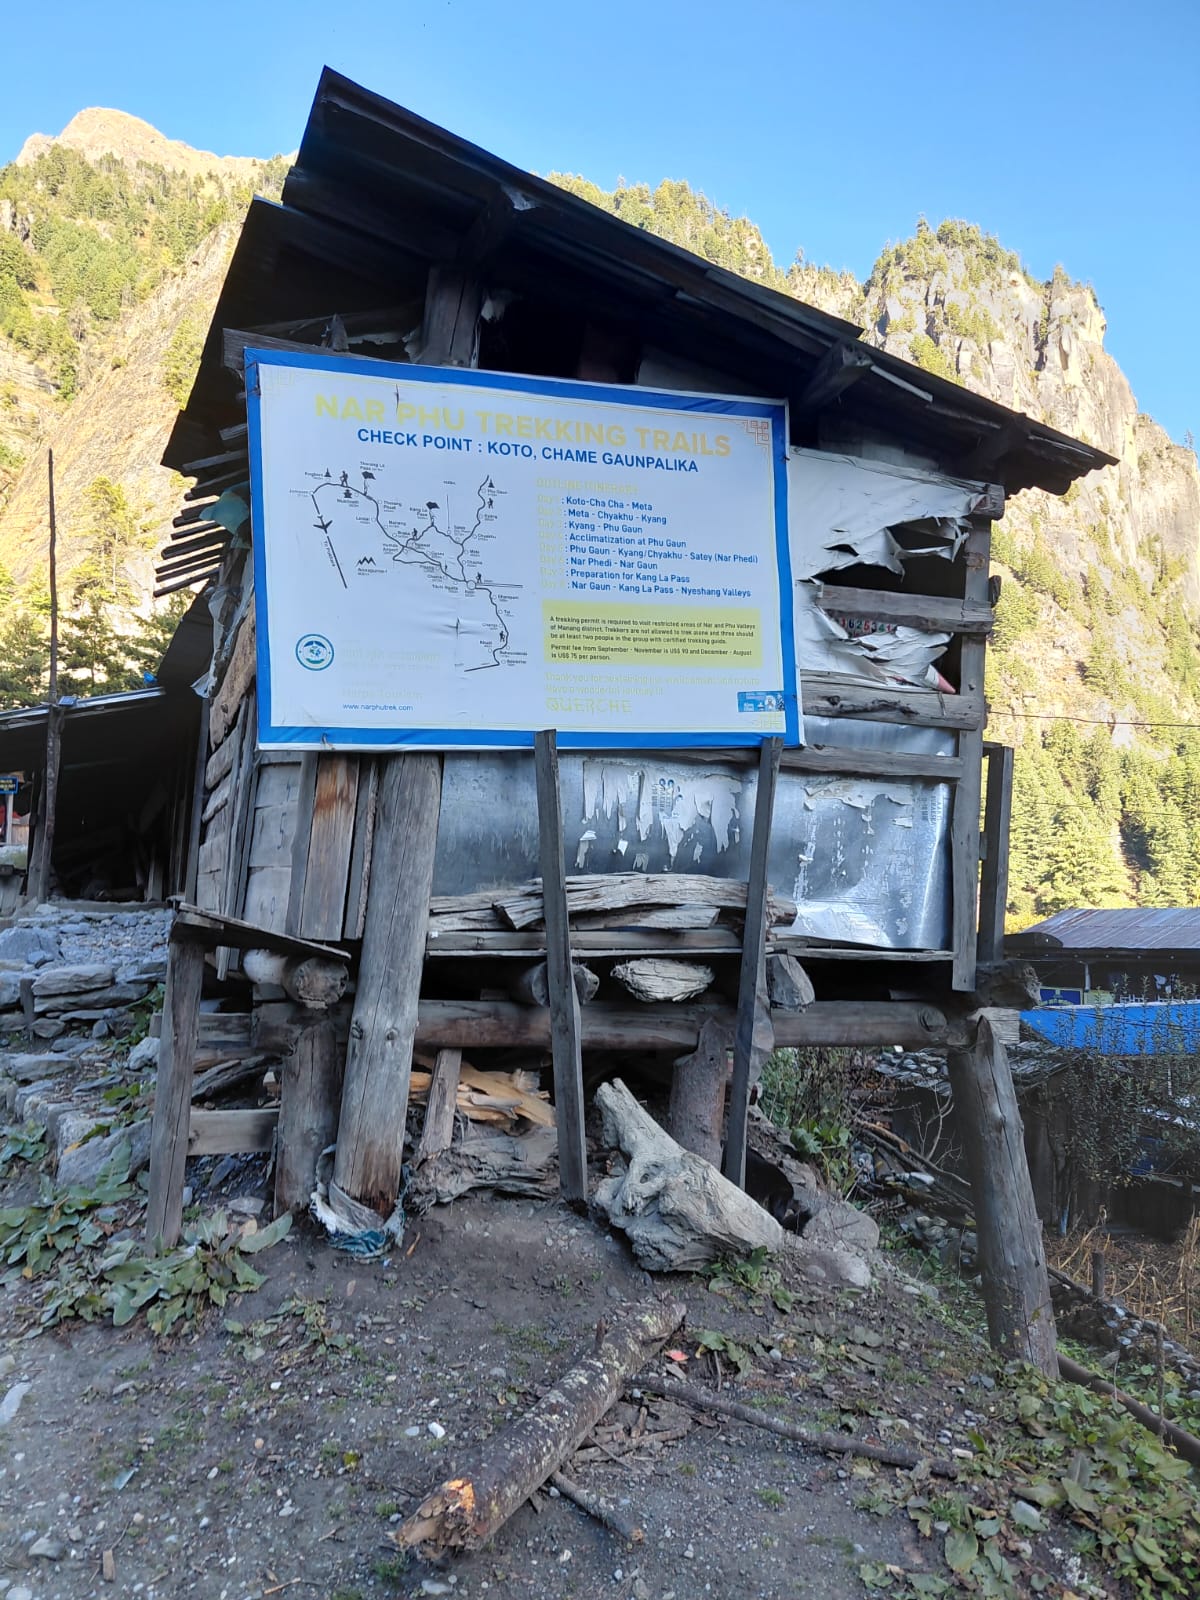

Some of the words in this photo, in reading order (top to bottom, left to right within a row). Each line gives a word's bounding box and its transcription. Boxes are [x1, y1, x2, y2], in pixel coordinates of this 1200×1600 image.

[315, 393, 385, 423] NAR
[399, 402, 465, 431] PHU
[475, 410, 626, 447] TREKKING
[634, 426, 731, 457] TRAILS
[357, 428, 418, 447] CHECK
[423, 435, 472, 451] POINT
[487, 441, 537, 460] KOTO,
[542, 447, 598, 464] CHAME
[602, 452, 698, 473] GAUNPALIKA
[566, 496, 606, 507] Koto-Cha
[608, 500, 624, 508] Cha
[632, 502, 652, 511] Meta
[568, 509, 589, 518] Meta
[598, 511, 634, 521] Chyakhu
[642, 514, 666, 525] Kyang
[569, 521, 595, 532] Kyang
[604, 523, 620, 532] Phu
[622, 524, 642, 534] Gaun
[570, 533, 636, 545] Acclimatization
[648, 538, 664, 546] Phu
[666, 539, 686, 548] Gaun
[570, 544, 586, 554] Phu
[588, 546, 610, 555] Gaun
[618, 548, 682, 560] Kyang/Chyakhu
[690, 552, 712, 562] Satey
[715, 553, 731, 562] (Nar
[734, 554, 758, 564] Phedi)
[570, 557, 586, 566] Nar
[588, 558, 612, 567] Phedi
[620, 560, 634, 568] Nar
[637, 561, 658, 570] Gaun
[571, 568, 620, 580] Preparation
[622, 572, 634, 580] for
[636, 572, 657, 583] Kang
[659, 574, 668, 582] La
[671, 574, 690, 583] Pass
[572, 581, 587, 590] Nar
[590, 582, 610, 591] Gaun
[619, 584, 640, 594] Kang
[654, 586, 674, 594] Pass
[682, 586, 720, 597] Nyeshang
[722, 588, 751, 598] Valleys
[343, 703, 414, 712] www.narphutrek.com
